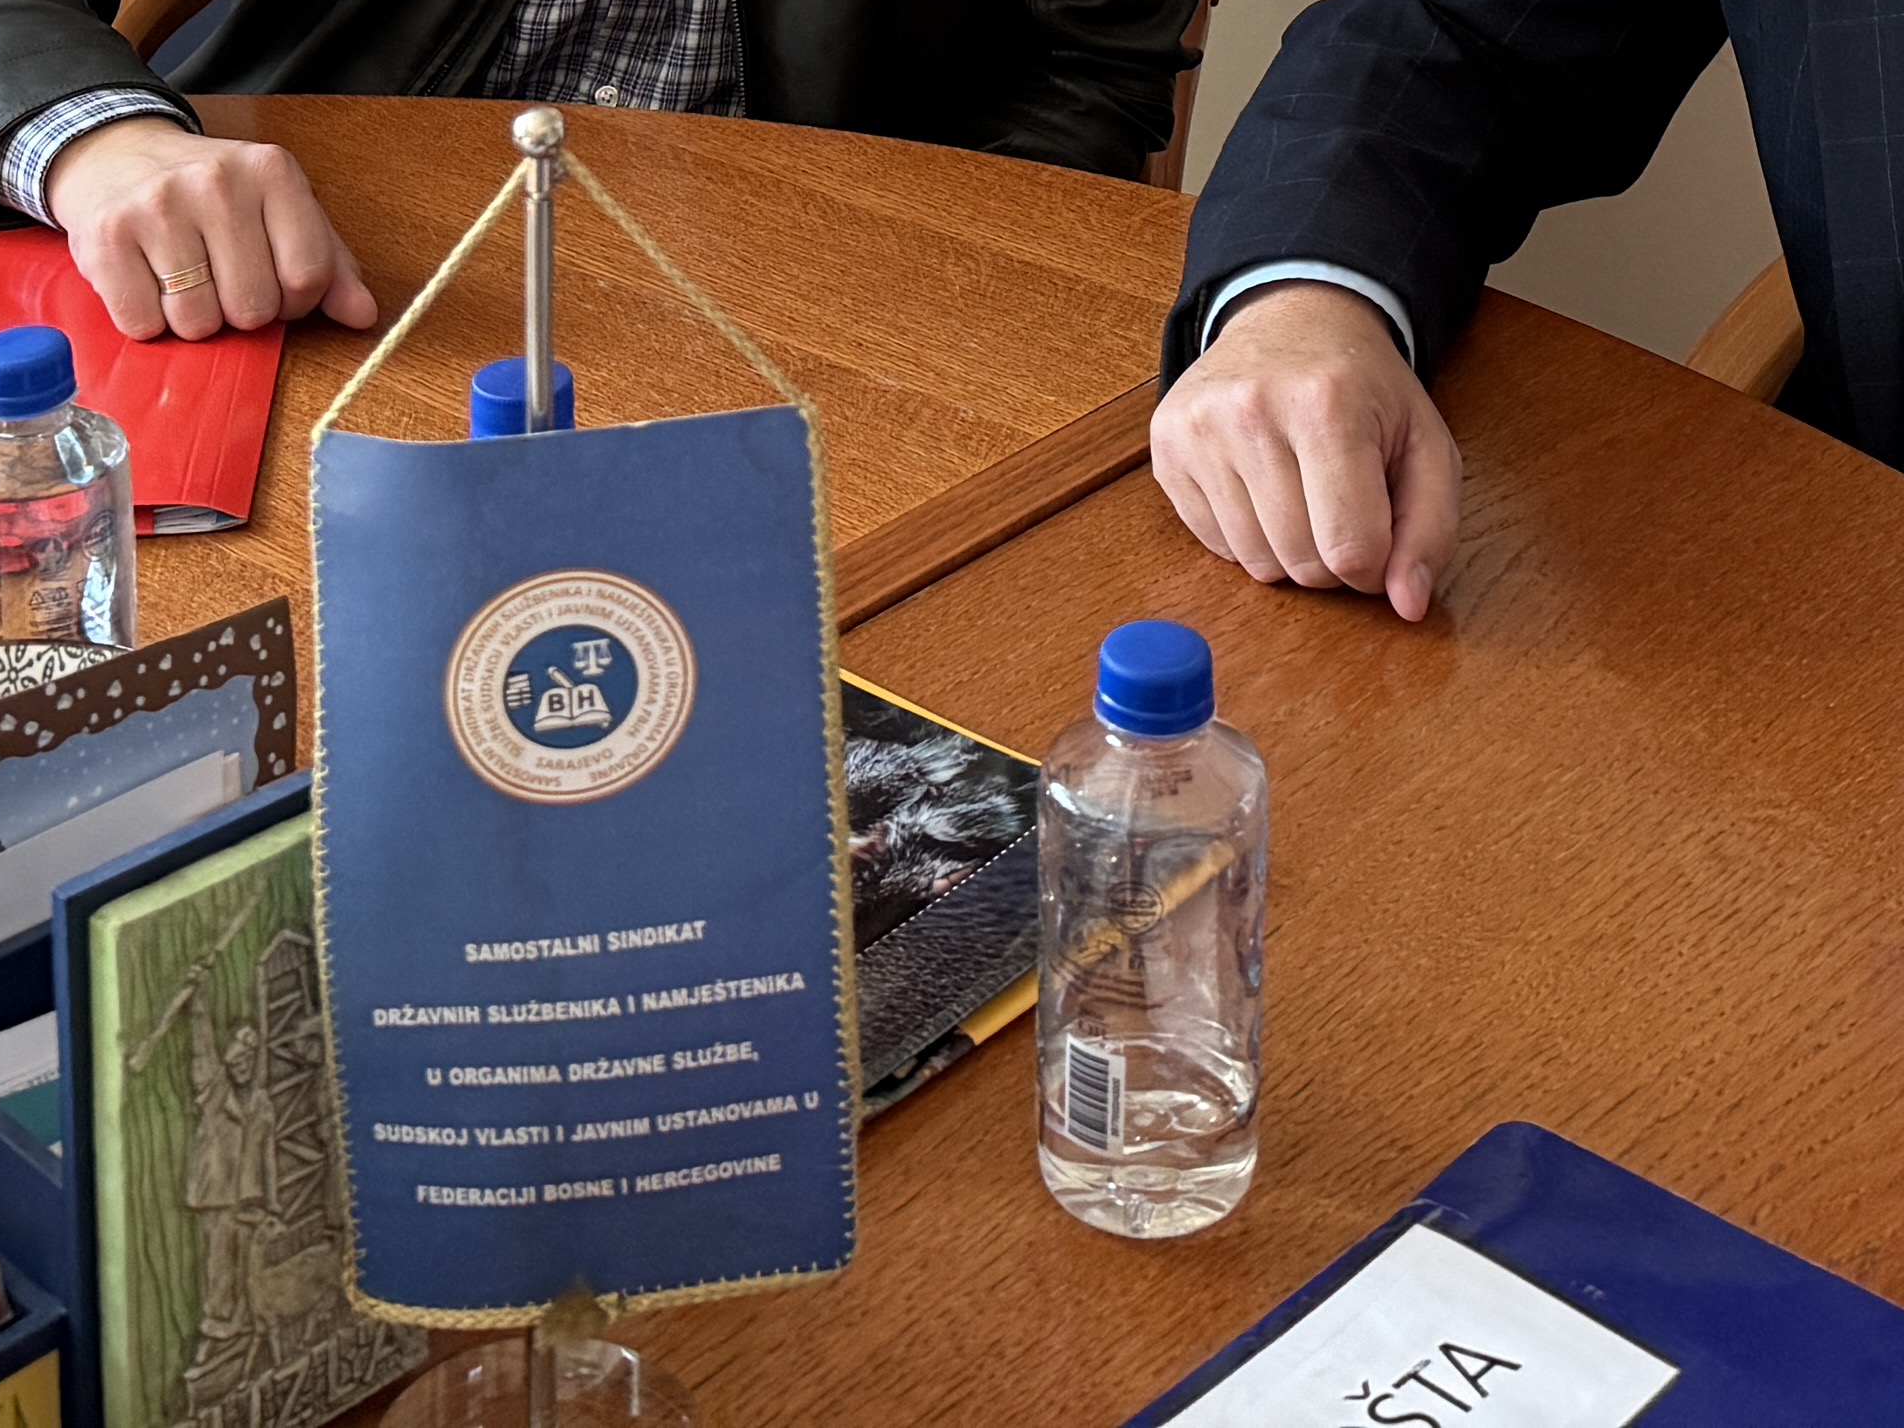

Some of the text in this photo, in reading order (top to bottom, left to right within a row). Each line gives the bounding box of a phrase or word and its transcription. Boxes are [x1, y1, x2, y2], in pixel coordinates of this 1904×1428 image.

[464, 920, 707, 963] SAMOSTALNI SINDIKAT
[373, 971, 806, 1028] DRŽAVNIH SLUŽBENIKA NAMJEŠTENIKA
[448, 1040, 760, 1086] ORGANIMA DRŽAVNE SLUŽBE,
[373, 1094, 798, 1146] SUDSKOJ VLASTI JAVNIM USTANOVAMA
[416, 1153, 782, 1207] FEDERACIJI BOSNE HERCEGOVINE
[1340, 1341, 1523, 1428] ŠTA
